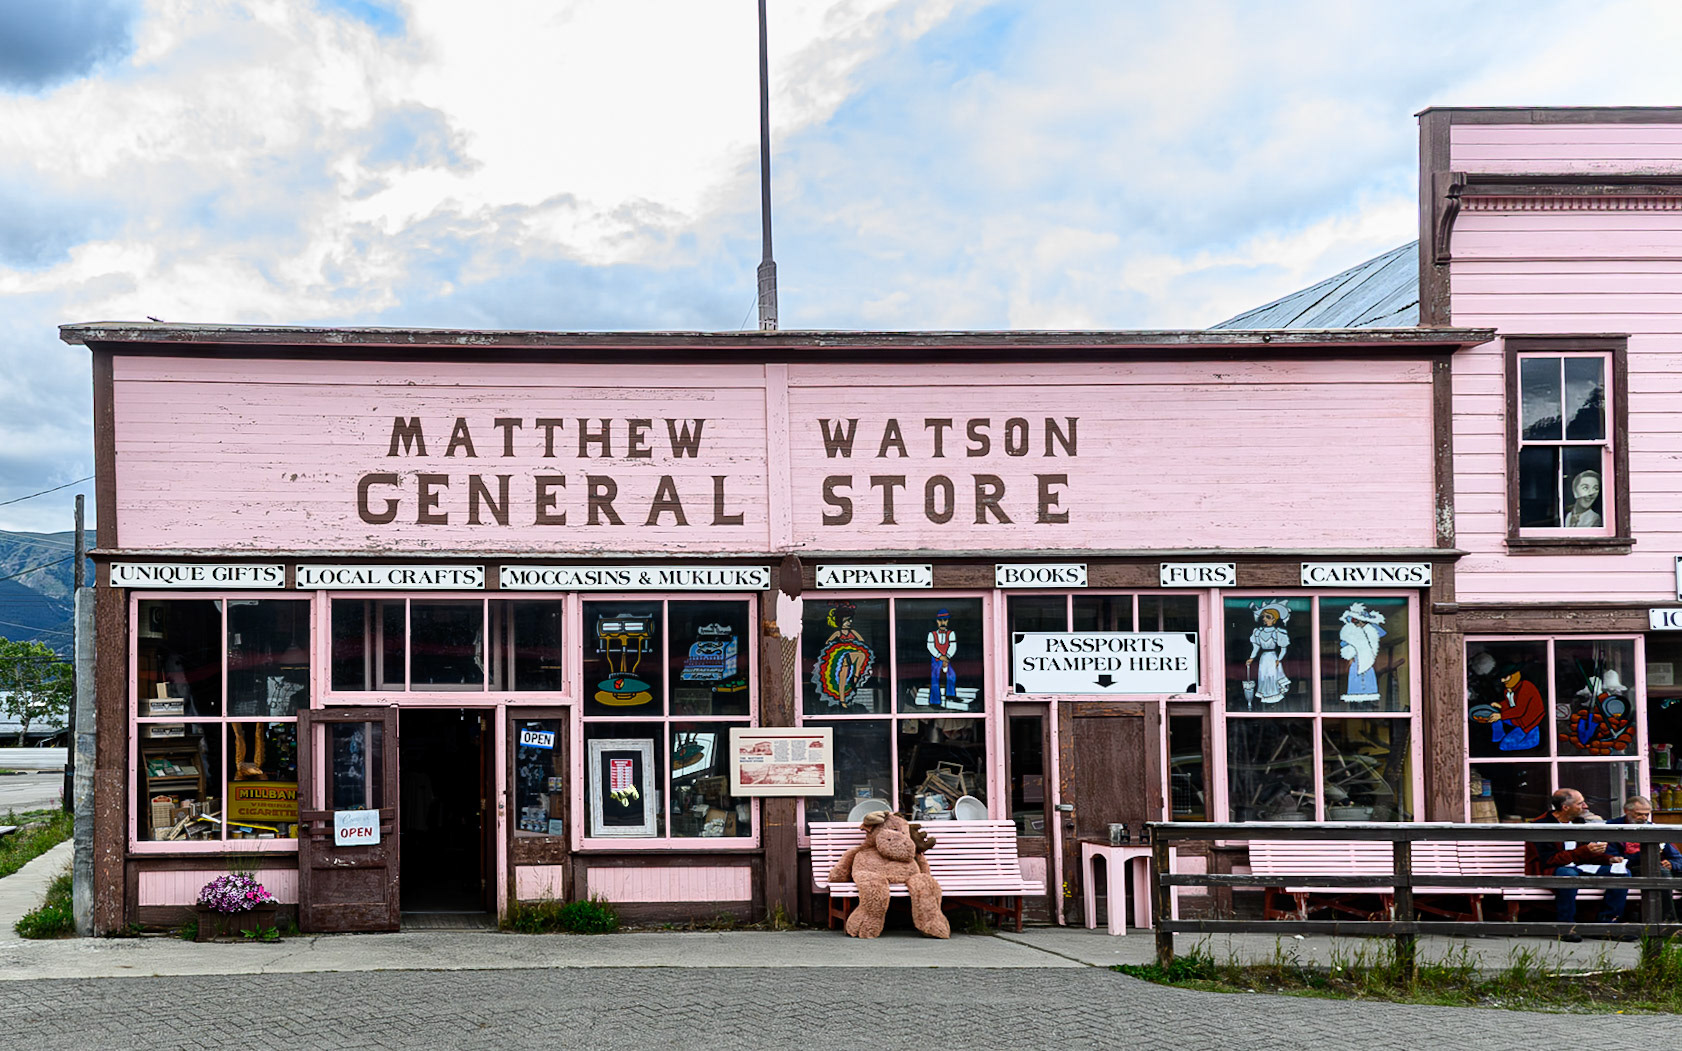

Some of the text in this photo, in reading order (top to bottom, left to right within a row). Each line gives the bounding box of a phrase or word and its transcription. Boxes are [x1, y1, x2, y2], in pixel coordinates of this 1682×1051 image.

[387, 416, 1080, 459] MATTHEW WATSON
[357, 473, 1070, 527] GENERAL STORE
[119, 566, 276, 584] UNIQUE GIFTS
[305, 568, 477, 586] LOCAL CRAFTS
[509, 569, 761, 586] MOCCASINS & MUKLUKS
[825, 569, 925, 585] APPAREL
[1005, 567, 1080, 584] BOOKS
[1170, 566, 1228, 583] FURS
[1309, 566, 1424, 583] CARVINGS
[1045, 637, 1165, 653] PASSPORTS
[1022, 656, 1189, 672] STAMPED HERE
[524, 732, 552, 745] OPEN
[340, 827, 373, 838] OPEN
